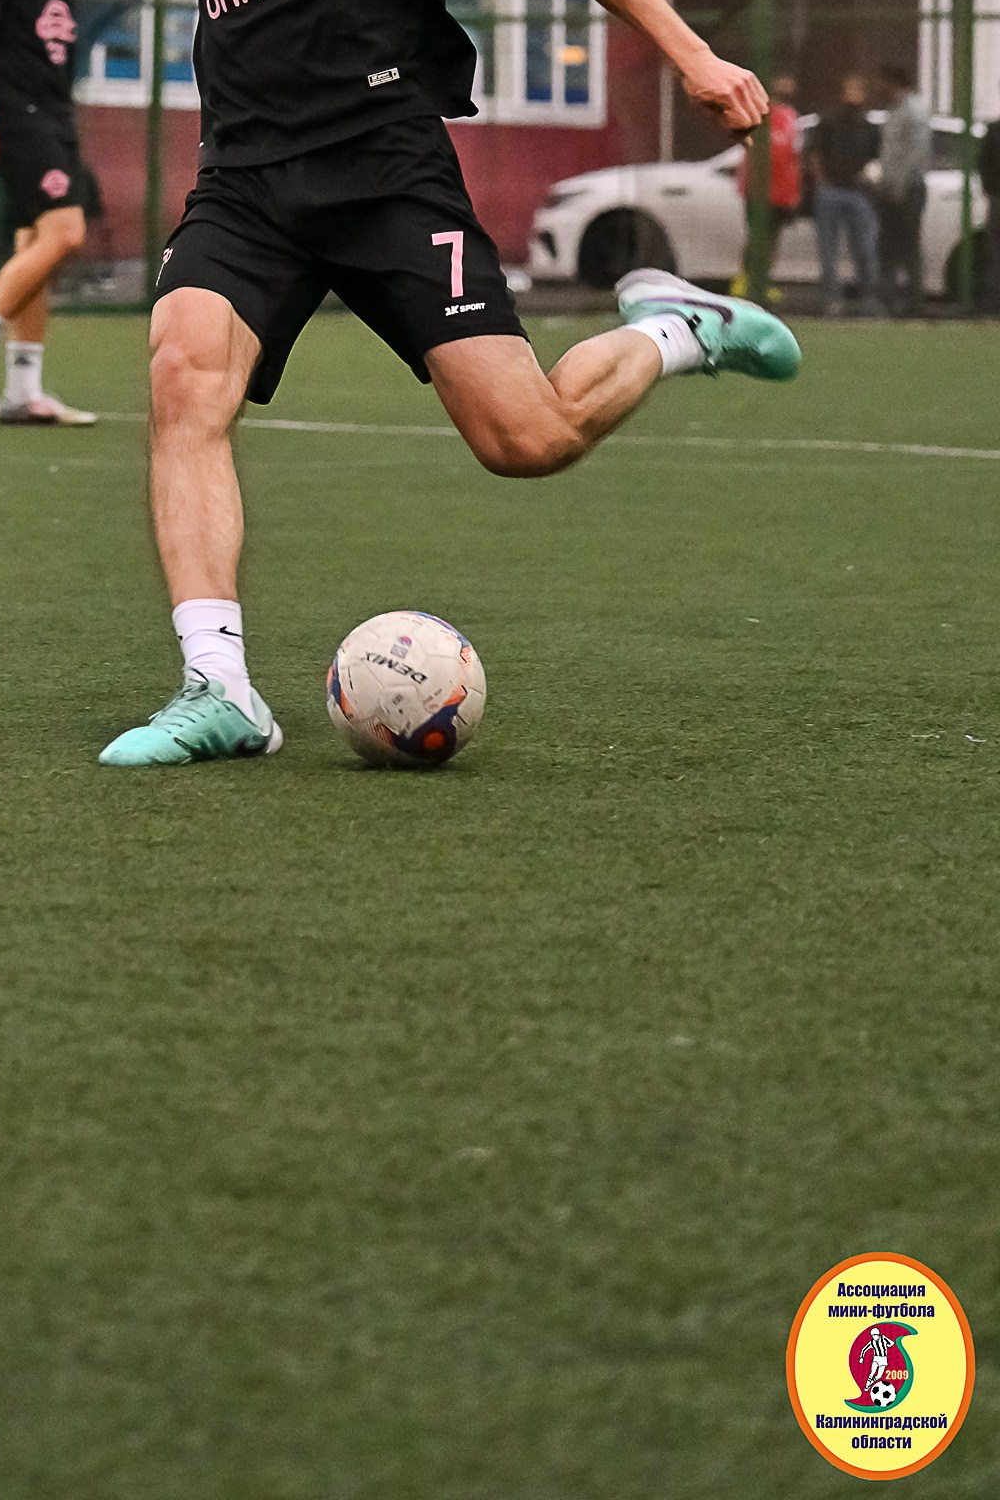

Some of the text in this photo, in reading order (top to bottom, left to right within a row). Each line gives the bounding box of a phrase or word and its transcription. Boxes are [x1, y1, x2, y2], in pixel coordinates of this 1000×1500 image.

[431, 230, 464, 298] 7
[444, 302, 486, 317] 2K SPORT
[365, 651, 428, 684] DEMIX
